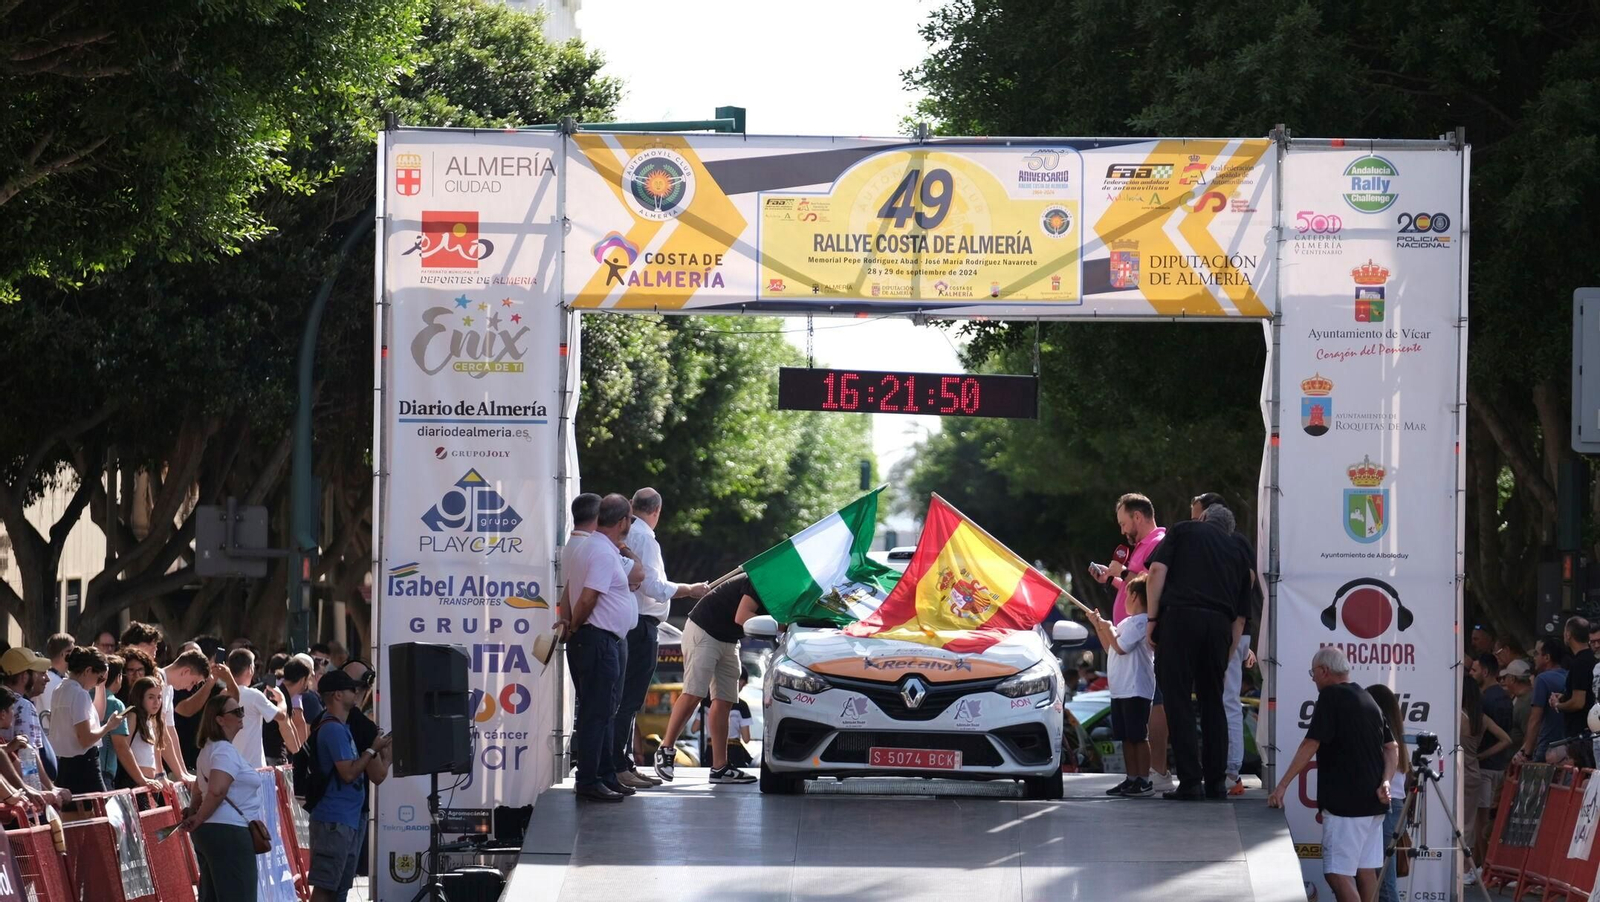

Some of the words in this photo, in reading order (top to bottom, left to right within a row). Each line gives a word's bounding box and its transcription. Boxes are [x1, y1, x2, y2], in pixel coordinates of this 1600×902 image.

[445, 152, 556, 177] ALMERÍA
[674, 157, 692, 177] CLUB
[1018, 170, 1069, 182] ANIVERSARIO
[445, 180, 501, 193] CIUDAD
[1351, 176, 1391, 193] Rally
[877, 168, 953, 229] 49
[1351, 194, 1390, 203] Challenge
[1295, 211, 1342, 234] 500
[1397, 212, 1451, 233] 200
[813, 233, 873, 252] RALLYE
[876, 233, 930, 253] COSTA
[933, 234, 955, 254] DE
[957, 230, 1033, 254] ALMERÍA
[644, 252, 699, 266] COSTA
[702, 253, 723, 266] DE
[807, 256, 842, 264] Memorial
[844, 257, 861, 265] Pepe
[863, 257, 899, 265] Rodríguez
[900, 257, 919, 265] Abad
[965, 258, 1001, 267] Rodríguez
[1149, 252, 1257, 269] DIPUTACIÓN
[420, 276, 473, 284] DEPORTES
[476, 276, 490, 284] DE
[628, 267, 725, 289] ALMERÍA
[907, 268, 946, 277] septiembre
[1149, 272, 1171, 285] DE
[1176, 269, 1252, 286] ALMERÍA
[411, 306, 531, 379] Enix
[1308, 328, 1383, 341] Ayuntamiento
[1385, 328, 1398, 339] de
[1401, 328, 1432, 340] Vícar
[1316, 347, 1358, 362] Corazón
[1360, 345, 1376, 356] del
[1379, 343, 1422, 356] Poniente
[454, 363, 490, 371] CERCA
[495, 363, 509, 371] DE
[513, 363, 523, 371] TI
[822, 372, 980, 414] 16:21:50
[399, 400, 453, 416] Diario
[455, 400, 475, 416] de
[476, 400, 547, 417] Almería
[417, 426, 529, 438] diariodealmeria.es
[480, 517, 518, 527] grupo
[1320, 552, 1367, 560] Ayuntamiento
[388, 575, 454, 597] Isabel
[459, 575, 540, 598] Alonso
[438, 598, 501, 606] TRANSPORTES
[409, 617, 530, 634] GRUPO
[1320, 642, 1415, 666] RCADOR
[794, 692, 816, 705] AON
[1010, 697, 1032, 709] AON
[484, 729, 528, 740] cáncer
[873, 751, 881, 763] S
[888, 751, 922, 765] 5074
[928, 753, 954, 766] BCK
